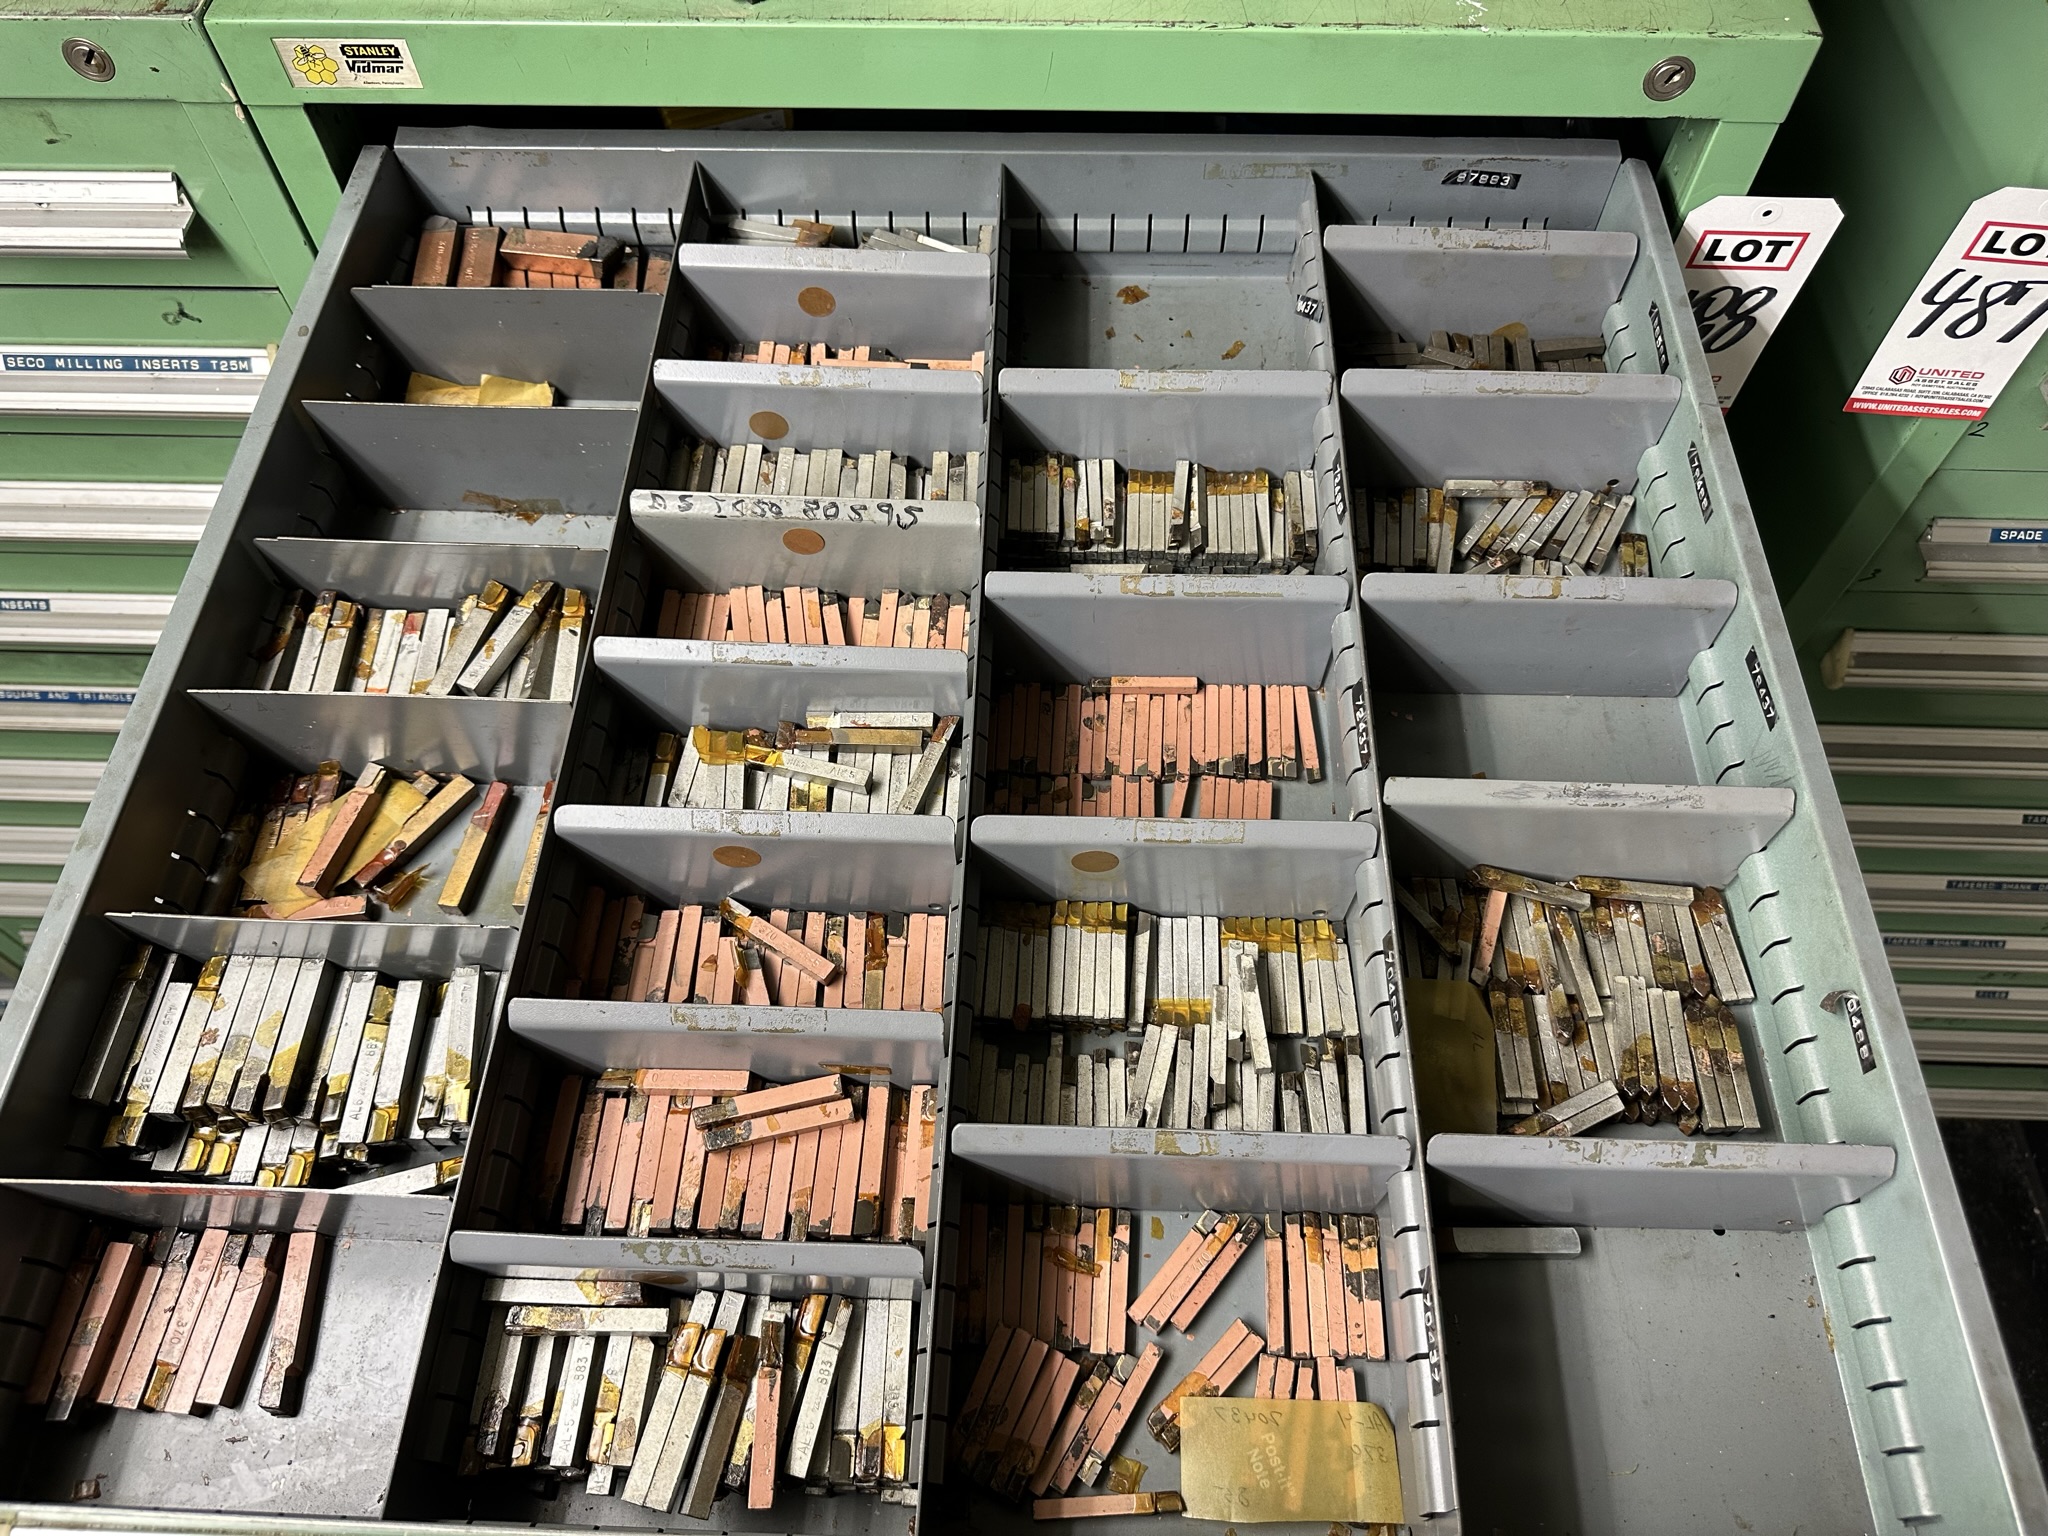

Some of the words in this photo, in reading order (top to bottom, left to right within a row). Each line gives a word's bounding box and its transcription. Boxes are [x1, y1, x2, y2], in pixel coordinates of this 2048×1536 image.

[344, 46, 396, 56] STANLEY
[345, 60, 404, 73] Vidmar
[1456, 172, 1511, 186] 87883
[1703, 238, 1794, 263] LOT
[1981, 230, 2048, 258] LO
[1907, 268, 2048, 343] 487
[6, 357, 46, 369] SECO
[55, 358, 123, 370] MILLING
[135, 359, 200, 371] INSERTS
[210, 360, 249, 371] T25M
[1918, 368, 1986, 379] UNITED
[1852, 401, 1982, 417] WWW.UNITEDASSETSALES.COM
[1968, 421, 1989, 437] 2
[1999, 530, 2043, 540] SPADE
[0, 691, 41, 699] SQUARE
[47, 692, 70, 700] AND
[77, 693, 133, 702] TRIANGLE
[1952, 881, 1996, 890] TAPERED
[2001, 882, 2031, 891] SHANK
[169, 1320, 190, 1347] 370
[817, 1359, 833, 1385] 883
[558, 1417, 575, 1452] AL-5
[574, 1356, 588, 1382] 883
[1247, 1448, 1270, 1490] Note
